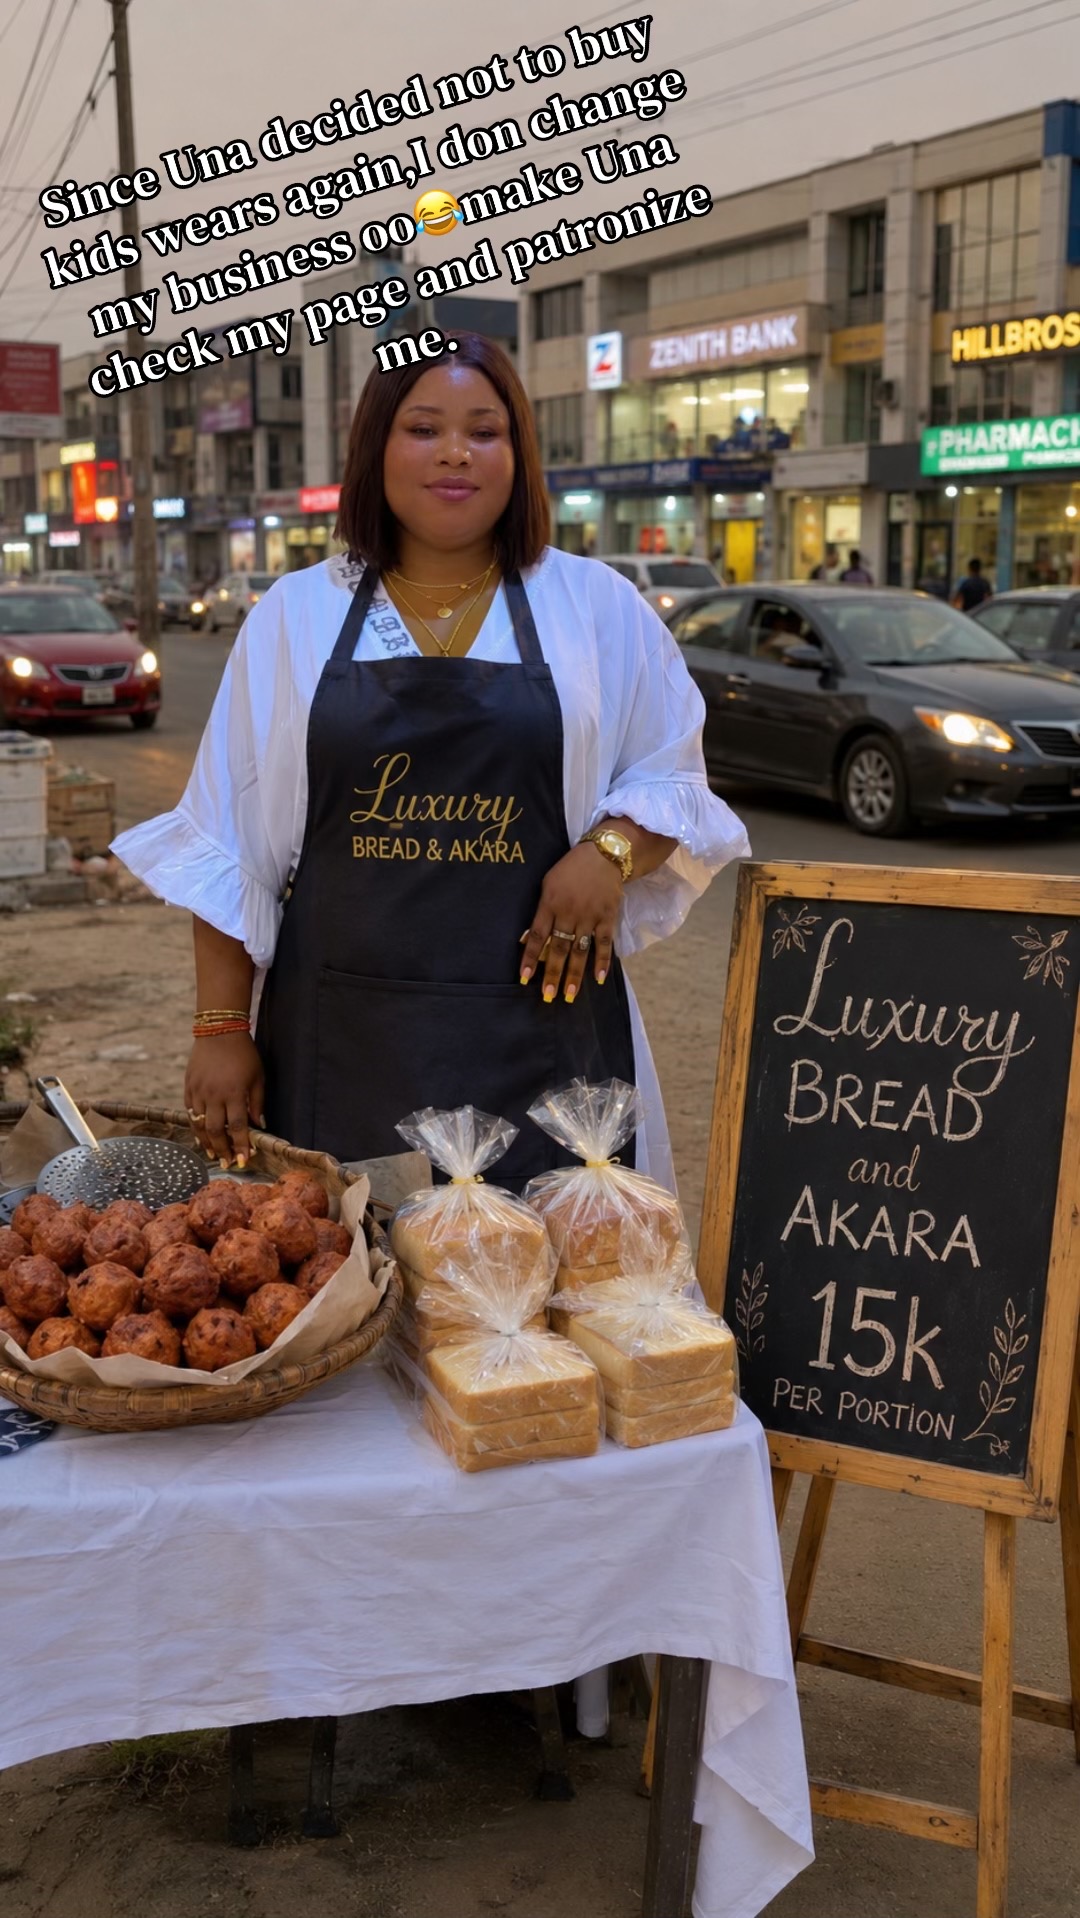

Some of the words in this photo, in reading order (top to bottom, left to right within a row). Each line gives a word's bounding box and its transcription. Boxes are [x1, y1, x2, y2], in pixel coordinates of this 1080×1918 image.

[649, 329, 727, 369] ZENITH
[731, 314, 798, 356] BANK
[951, 311, 1080, 362] HILLBROS
[350, 753, 523, 849] Luxury
[352, 836, 420, 860] BREAD
[426, 838, 443, 861] &
[448, 839, 525, 863] AKARA
[773, 917, 1035, 1097] Luxury
[784, 1058, 983, 1142] BREAD
[848, 1144, 921, 1192] and
[780, 1184, 981, 1269] AKARA
[772, 1377, 824, 1416] PER
